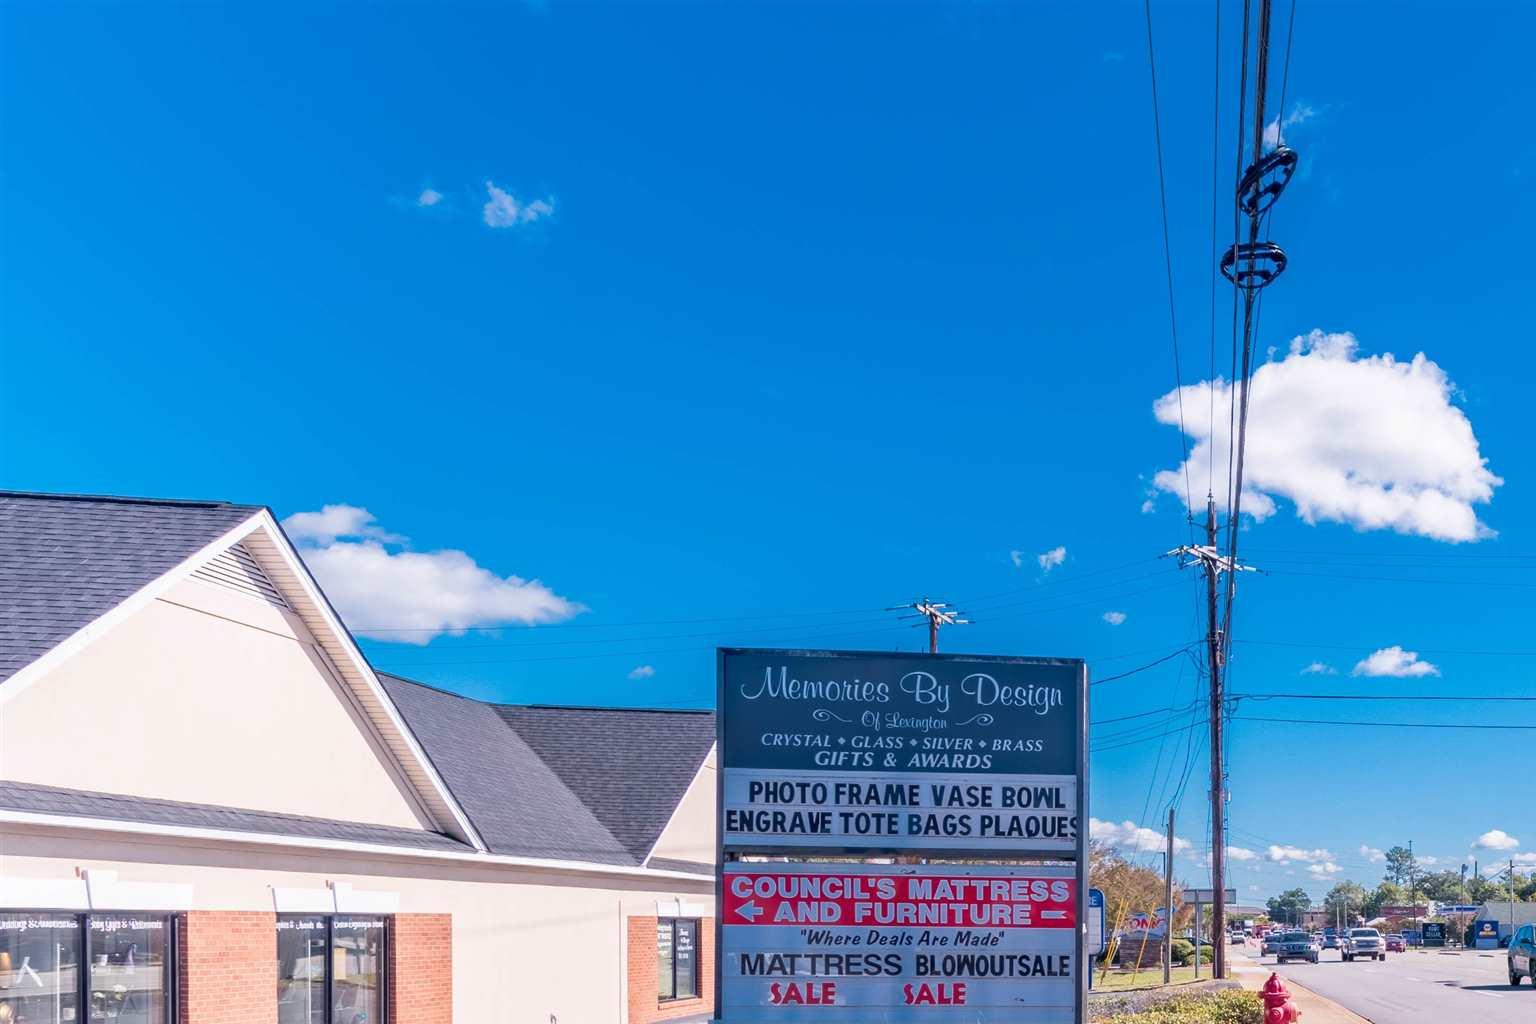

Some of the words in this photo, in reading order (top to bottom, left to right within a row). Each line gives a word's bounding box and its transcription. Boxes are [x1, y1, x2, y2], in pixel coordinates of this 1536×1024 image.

[741, 666, 889, 702] Memories
[900, 671, 950, 713] By
[961, 673, 1063, 715] Design
[861, 710, 881, 732] Of
[885, 711, 947, 733] Lexington
[761, 733, 832, 748] CRYSTAL
[851, 737, 904, 750] GLASS
[922, 737, 973, 751] SILVER
[992, 738, 1044, 752] BRASS
[814, 751, 875, 767] GIFTS
[883, 753, 898, 768] &
[907, 753, 993, 769] AWARDS
[750, 781, 827, 805] PHOTO
[835, 782, 920, 806] FRAME
[932, 785, 994, 808] VASE
[1001, 786, 1066, 809] BOWL
[726, 810, 832, 834] ENGRAVE
[839, 812, 898, 836] TOTE
[908, 813, 972, 837] BAGS
[980, 815, 1078, 838] PLAQUES
[731, 876, 896, 899] COUNCIL'S
[908, 879, 1070, 902] MATTRESS
[774, 901, 842, 923] AND
[855, 903, 1032, 925] FURNITURE
[800, 929, 861, 946] "Where
[866, 930, 914, 946] Deals
[918, 931, 949, 947] Are
[953, 931, 1004, 947] Made"
[740, 954, 903, 976] MATTRESS
[770, 982, 836, 1005] SALE
[903, 982, 967, 1005] SALE
